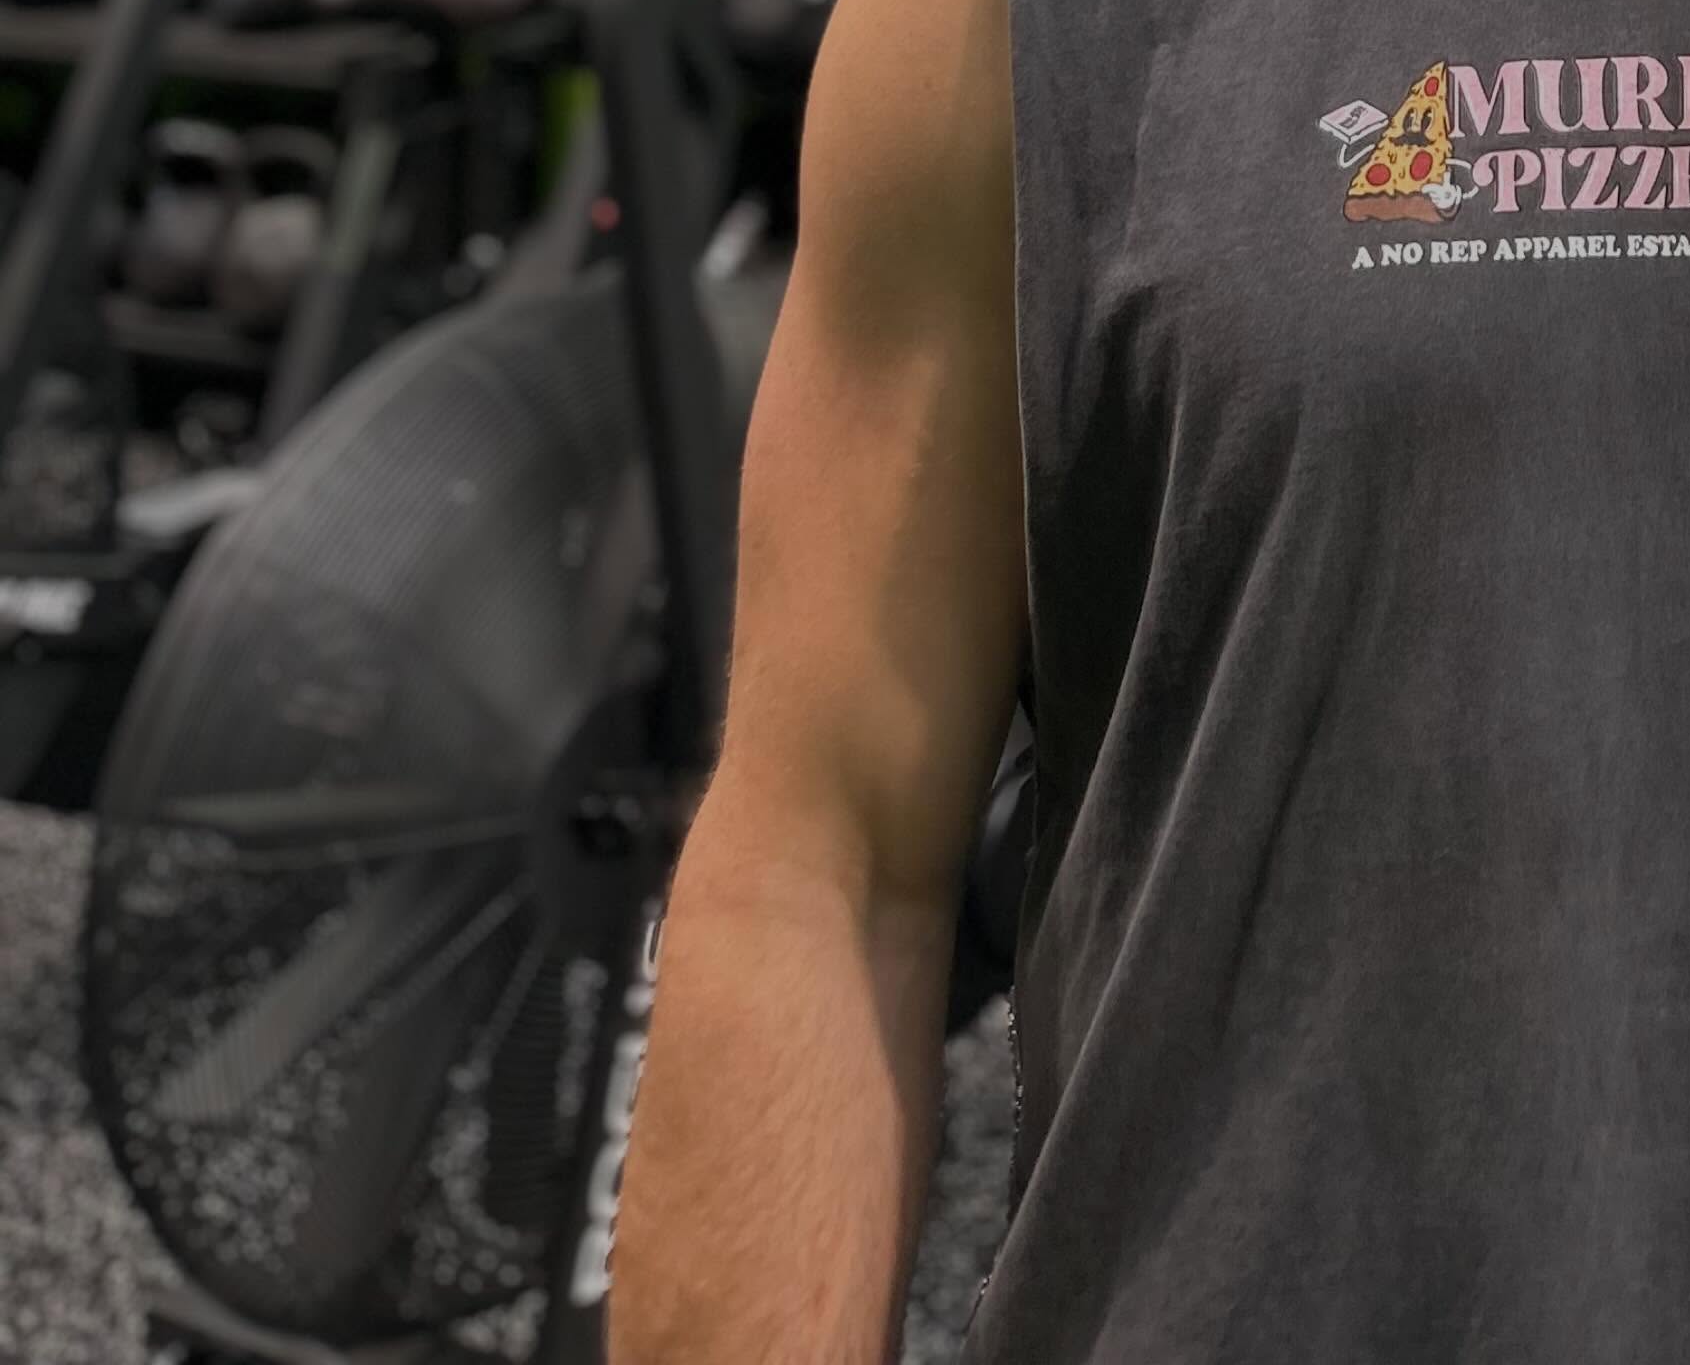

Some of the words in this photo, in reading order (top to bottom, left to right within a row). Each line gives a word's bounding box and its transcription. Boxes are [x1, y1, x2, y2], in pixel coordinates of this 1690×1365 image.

[1352, 246, 1375, 269] A
[1381, 242, 1424, 267] NO
[1430, 239, 1487, 264] REP
[1493, 235, 1621, 261] APPAREL
